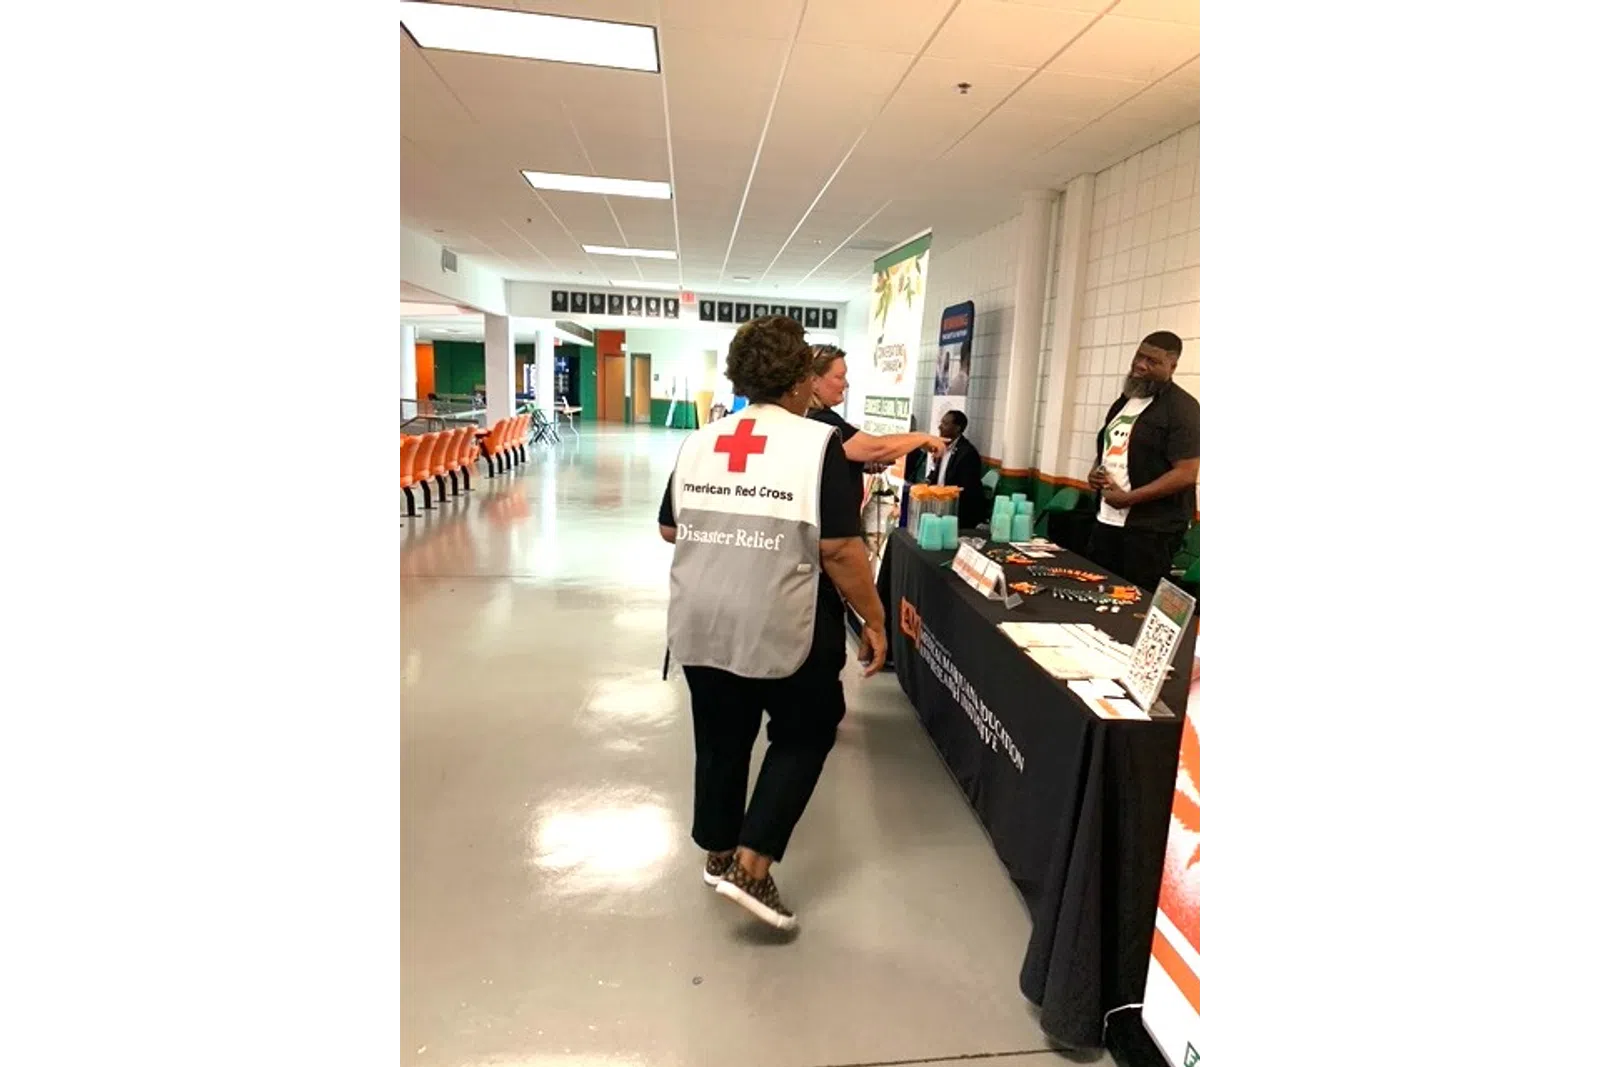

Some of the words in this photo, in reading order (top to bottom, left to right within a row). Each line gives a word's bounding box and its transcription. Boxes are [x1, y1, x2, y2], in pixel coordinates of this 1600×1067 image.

[683, 483, 731, 496] merican
[735, 485, 756, 497] Red
[759, 486, 794, 501] Cross
[676, 523, 734, 545] Disaster
[735, 529, 785, 550] Relief
